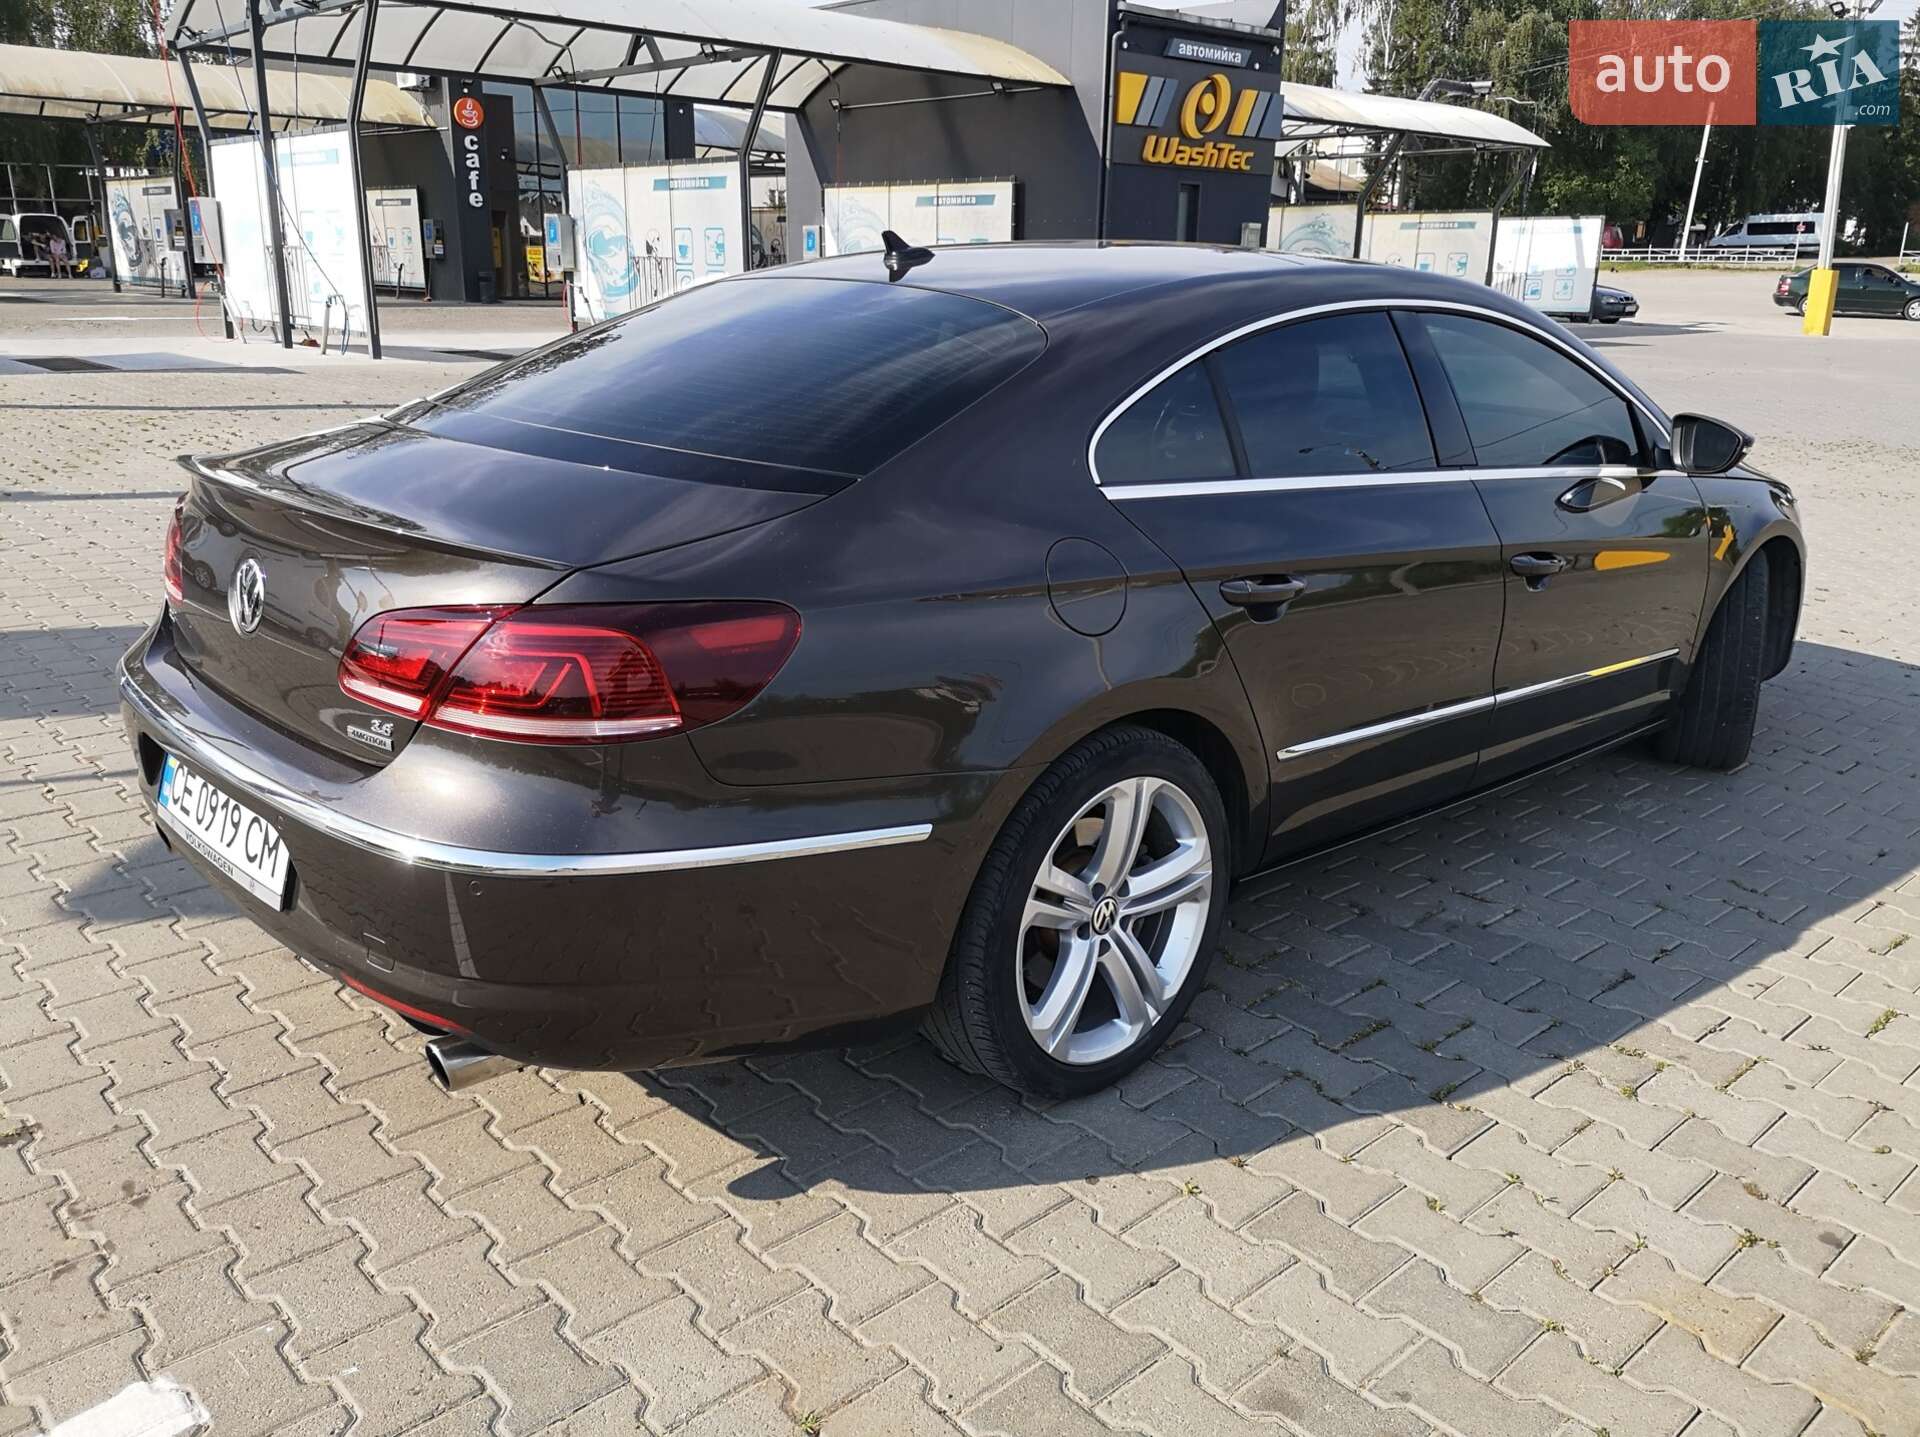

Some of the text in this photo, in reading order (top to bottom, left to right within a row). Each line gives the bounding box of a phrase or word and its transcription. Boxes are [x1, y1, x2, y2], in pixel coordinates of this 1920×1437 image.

[1178, 42, 1242, 63] автомийка
[463, 134, 484, 208] cafe
[1143, 134, 1254, 170] WashTec
[172, 764, 281, 878] CE 0919 CM
[185, 830, 234, 877] VOLKSWAGEN
